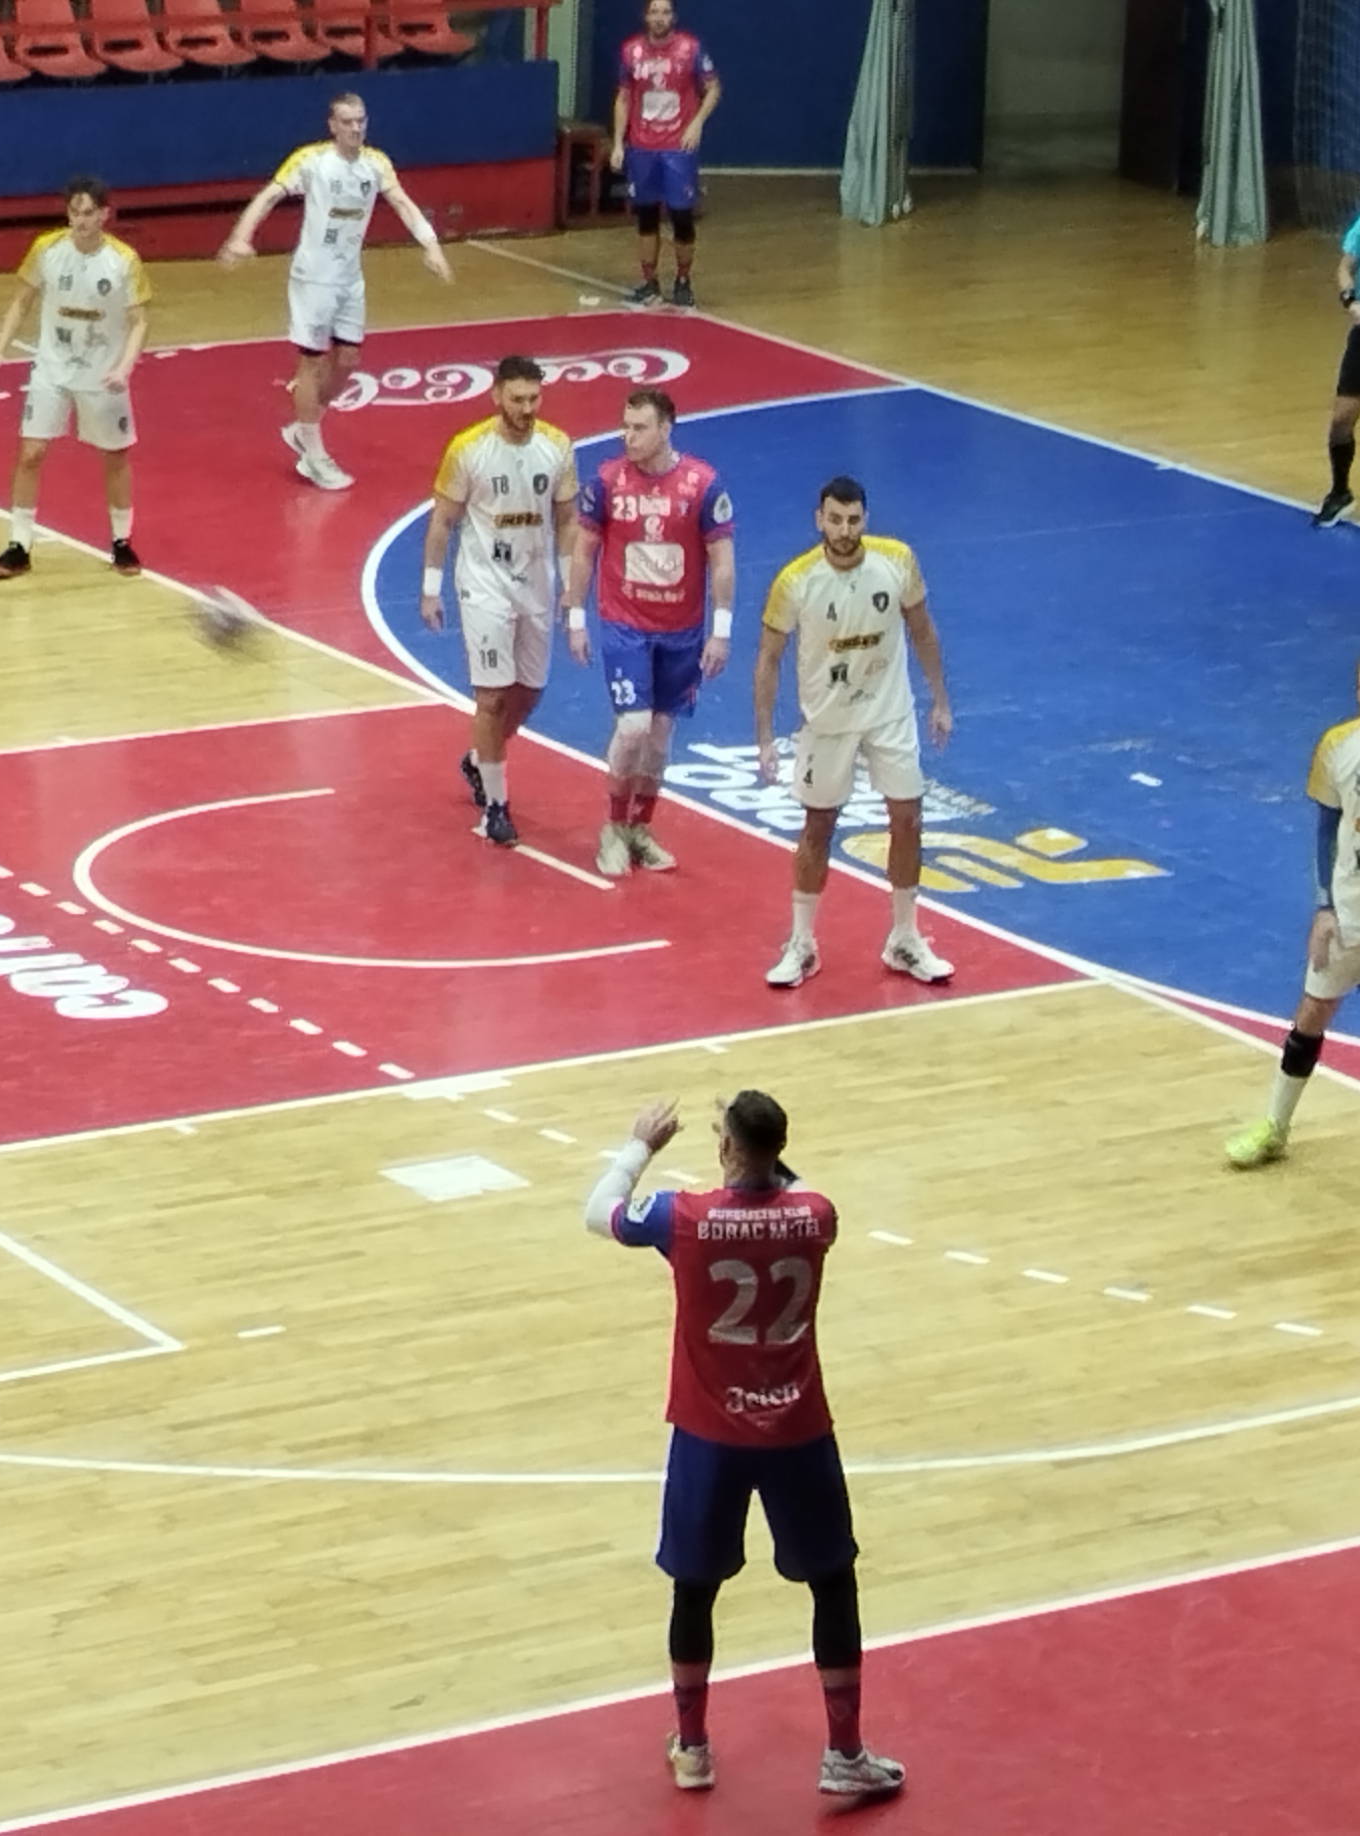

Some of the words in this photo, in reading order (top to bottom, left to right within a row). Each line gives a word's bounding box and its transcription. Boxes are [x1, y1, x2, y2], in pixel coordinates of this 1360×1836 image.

[611, 494, 638, 523] 23
[610, 678, 637, 706] 23
[707, 1255, 814, 1346] 22
